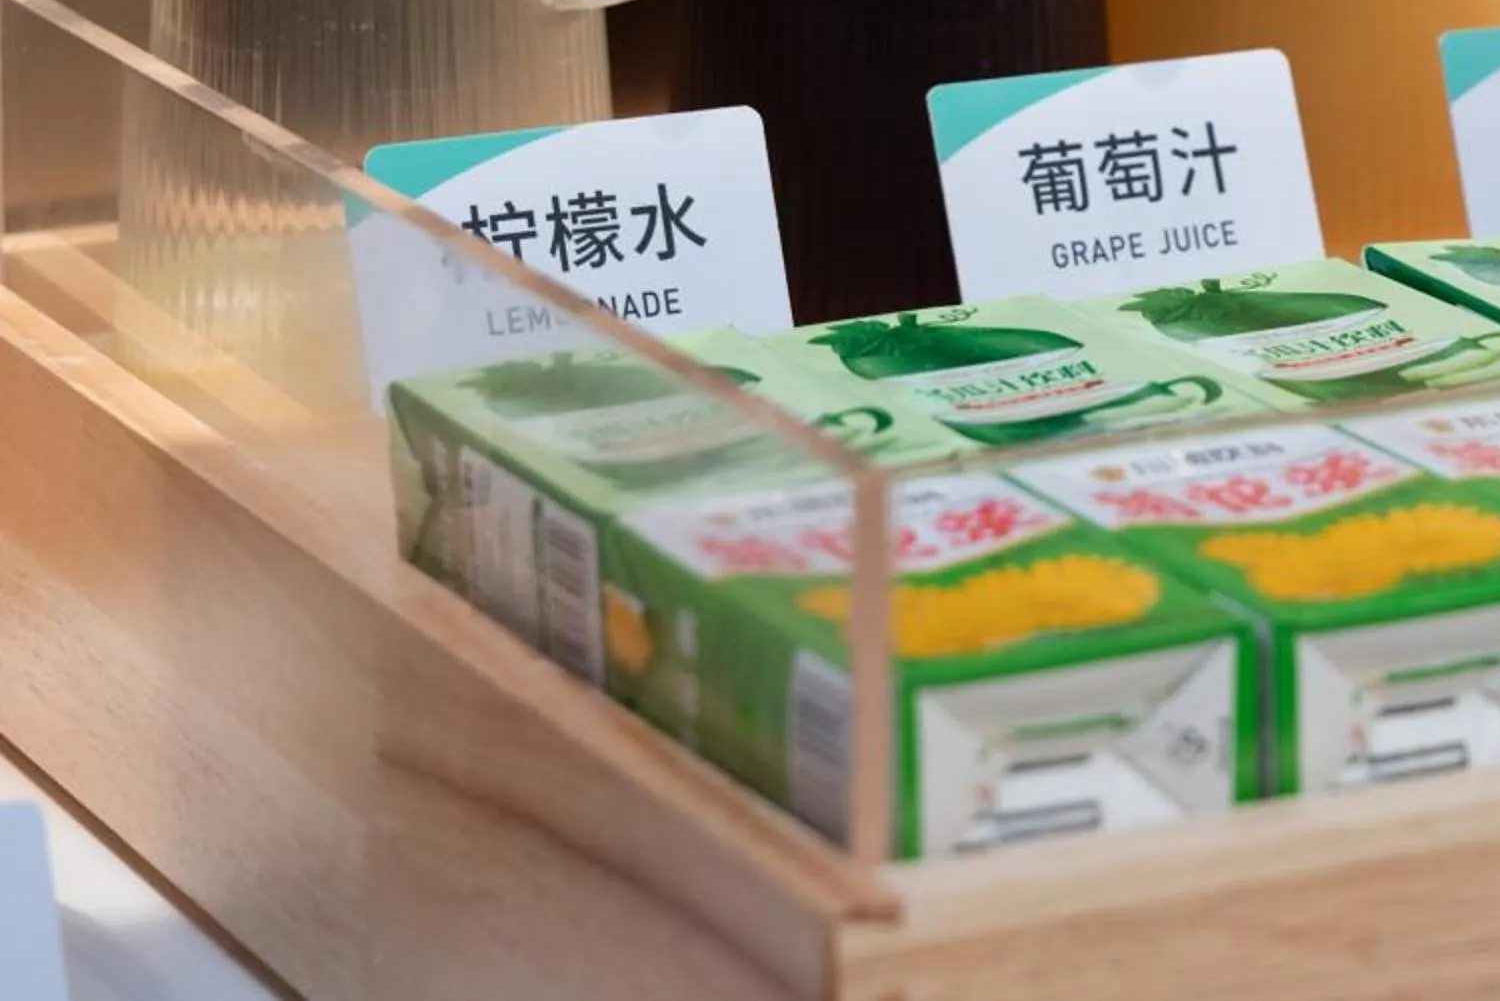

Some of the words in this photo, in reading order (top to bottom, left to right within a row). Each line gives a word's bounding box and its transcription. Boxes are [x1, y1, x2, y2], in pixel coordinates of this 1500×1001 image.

[1018, 121, 1238, 215] 葡萄汁
[461, 183, 707, 272] 柠檬水
[1051, 232, 1146, 269] GRAPE
[1160, 220, 1239, 256] JUICE
[486, 288, 683, 337] LEMNADE
